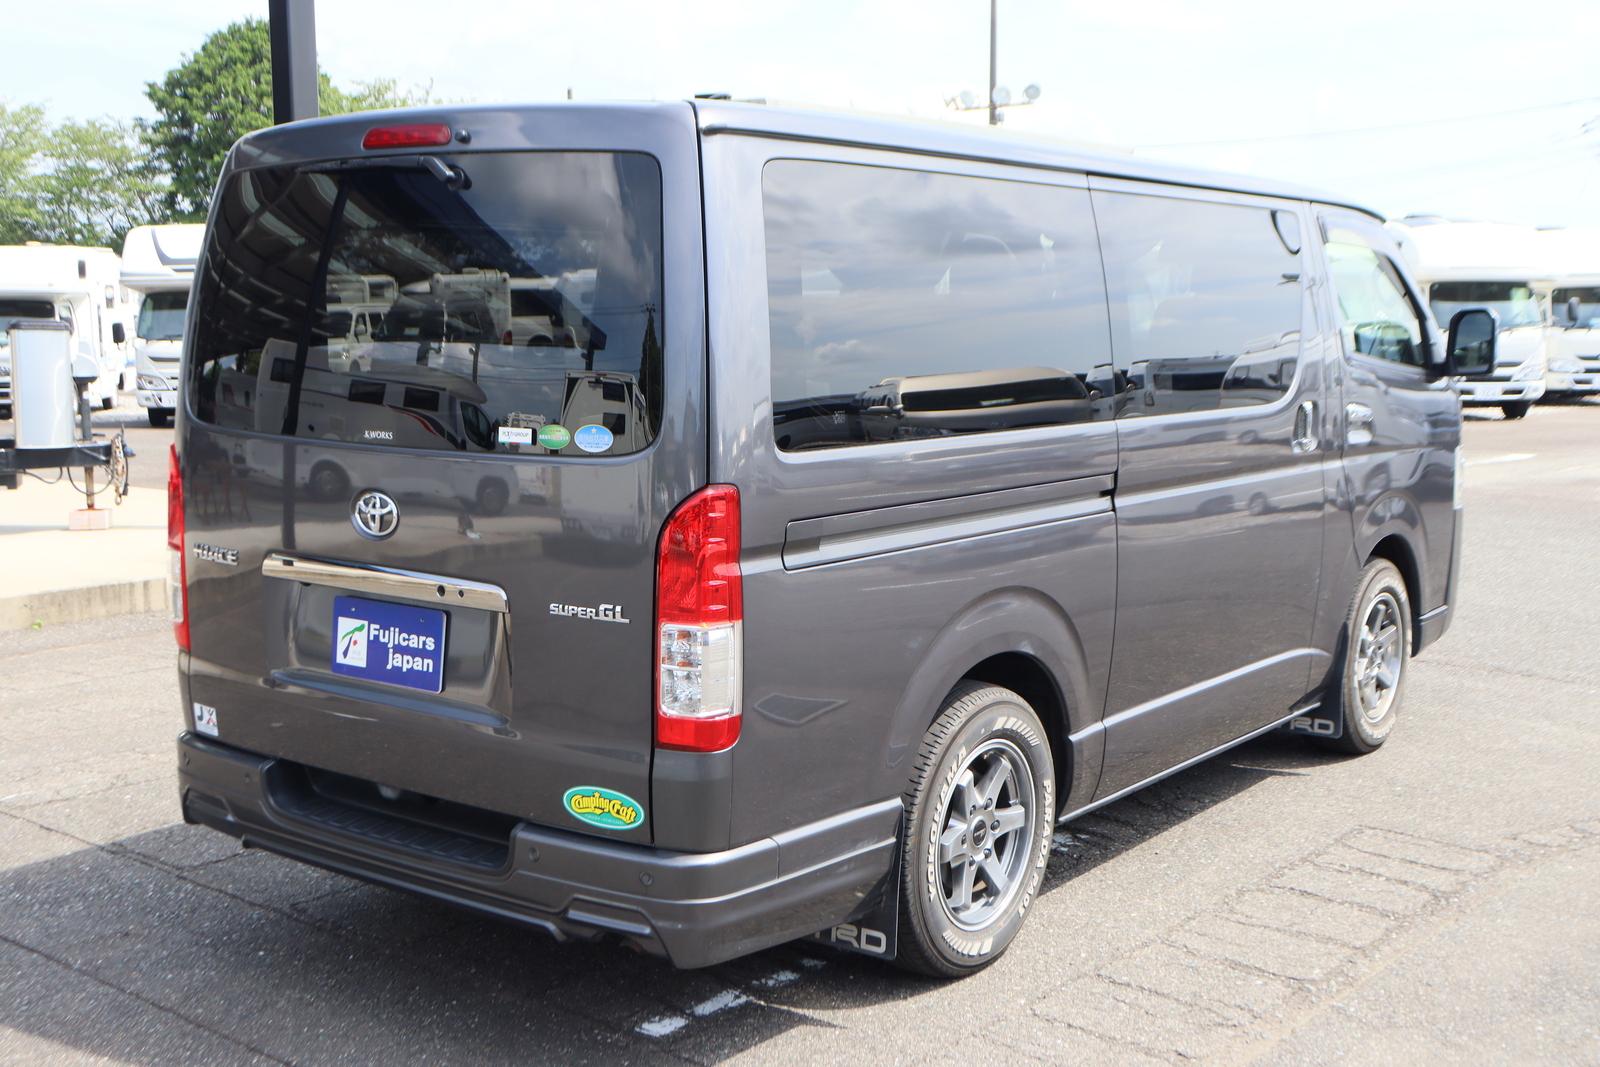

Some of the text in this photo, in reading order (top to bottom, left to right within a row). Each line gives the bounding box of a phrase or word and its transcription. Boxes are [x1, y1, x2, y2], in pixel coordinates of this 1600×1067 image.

[192, 542, 240, 567] HIACE
[550, 603, 631, 624] SUPER GL
[369, 623, 435, 651] Fujicars
[386, 648, 434, 673] japan
[1278, 716, 1335, 735] RD
[570, 791, 610, 816] Camping
[609, 798, 638, 825] Craft
[926, 744, 967, 902] YOKOHAMA
[1035, 779, 1053, 869] PARADA
[814, 922, 887, 955] RD
